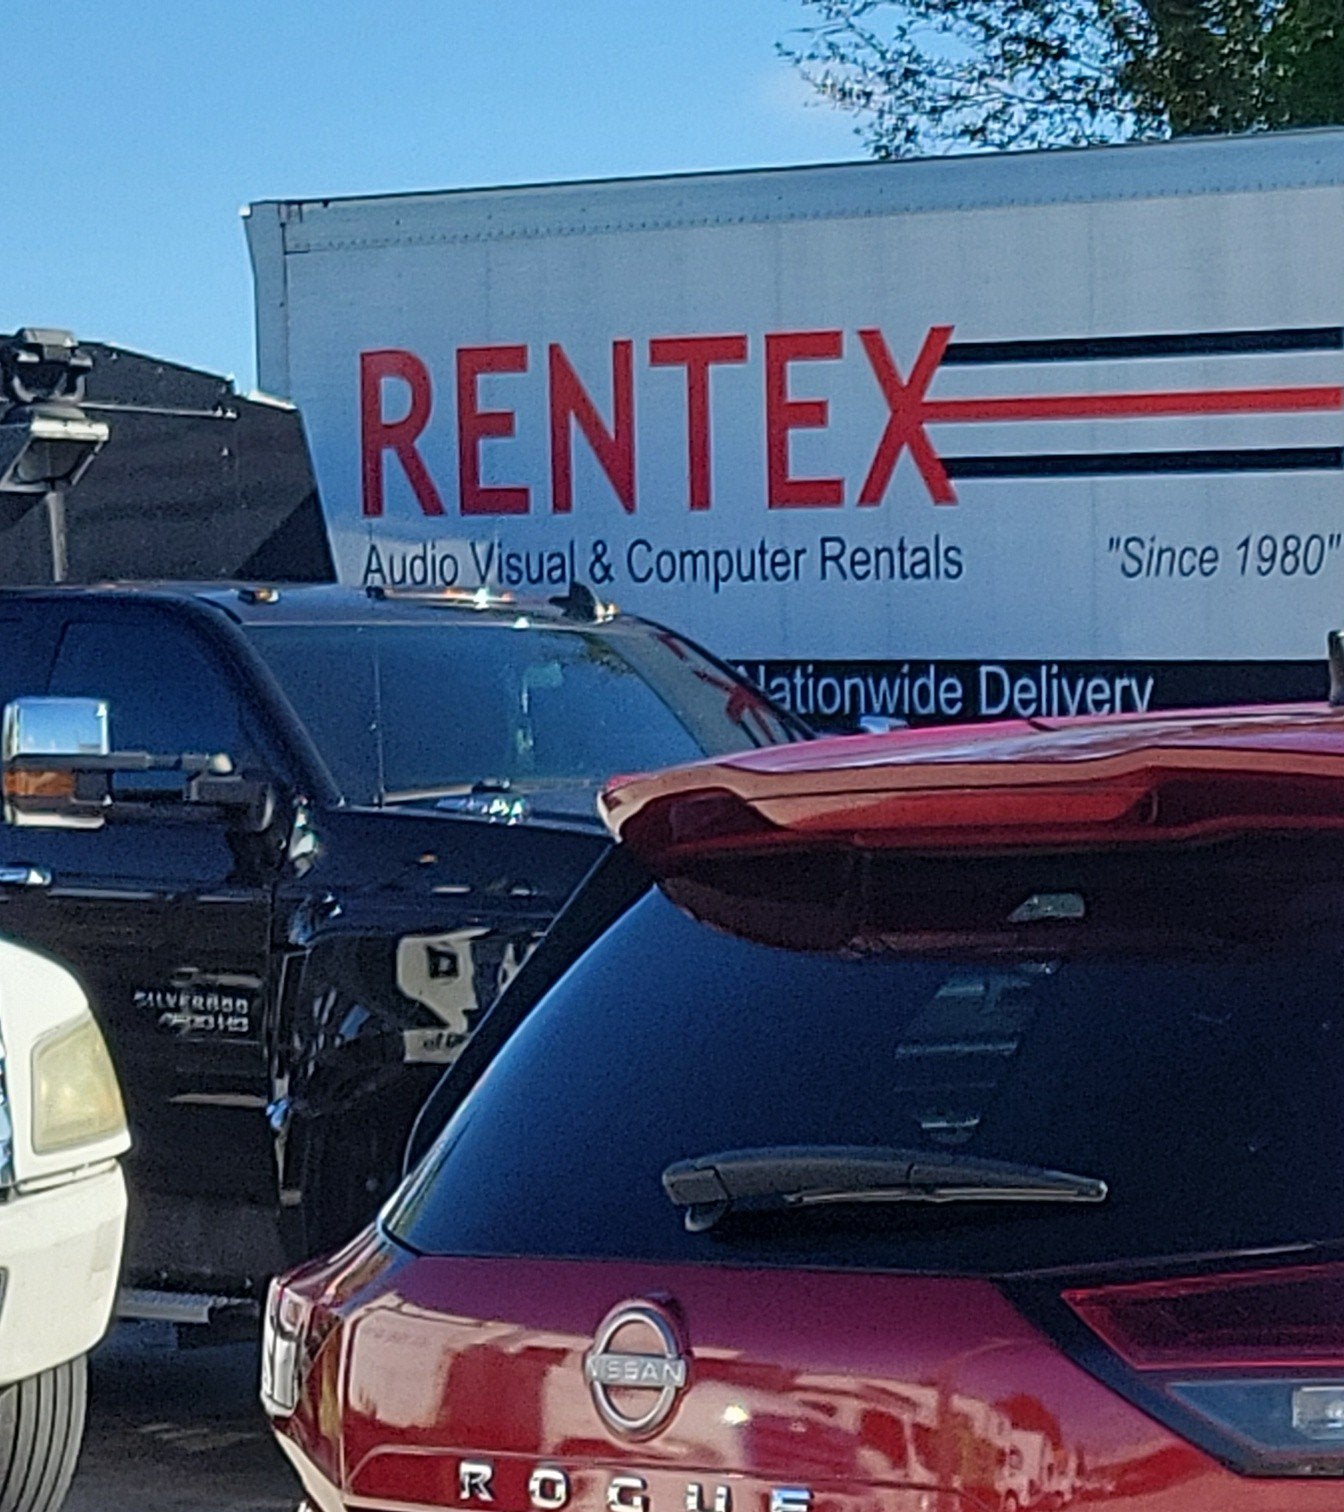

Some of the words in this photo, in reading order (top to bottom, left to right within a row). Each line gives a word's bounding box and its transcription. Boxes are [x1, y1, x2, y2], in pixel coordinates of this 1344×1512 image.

[358, 326, 959, 516] RENTEX
[363, 543, 459, 587] Audio
[471, 541, 575, 585] Visual
[590, 541, 615, 583] &
[627, 538, 806, 593] Computer
[820, 535, 964, 582] Rentals
[1107, 536, 1219, 579] "Since
[1236, 533, 1342, 577] 1980"
[979, 664, 1155, 718] Delivery
[587, 1360, 682, 1382] NISSAN
